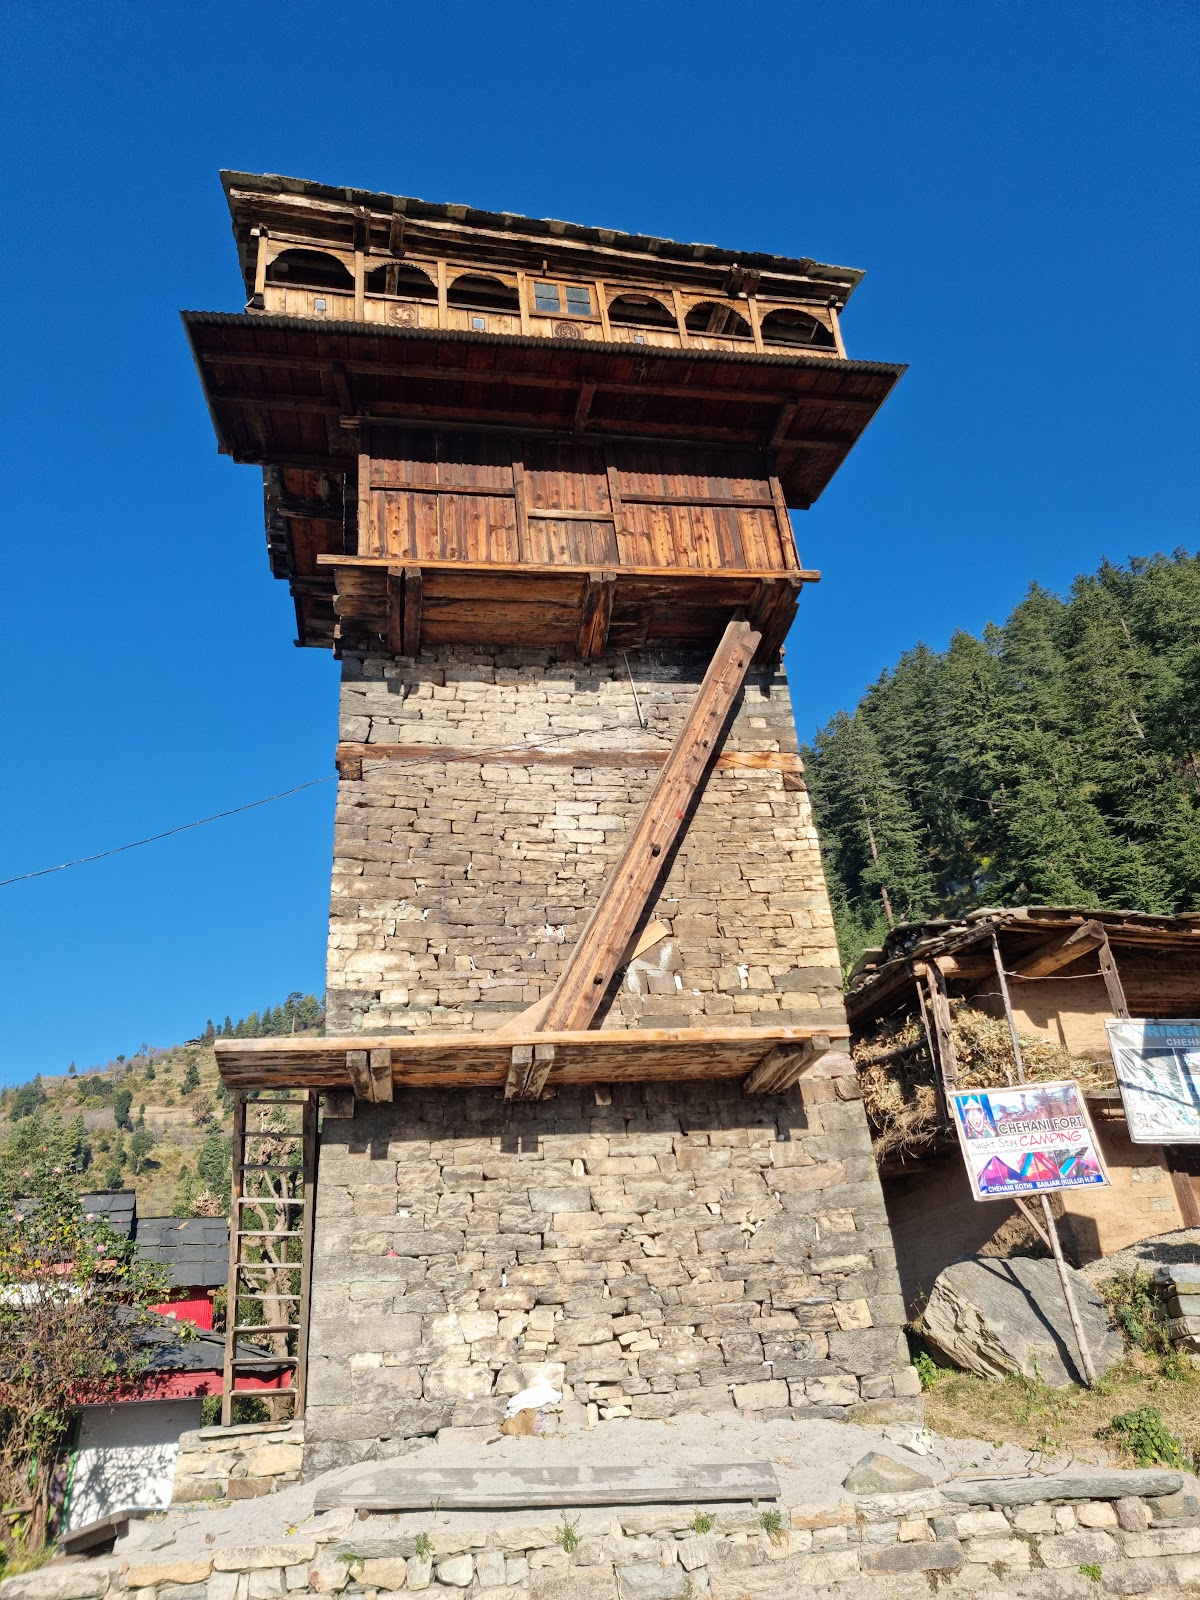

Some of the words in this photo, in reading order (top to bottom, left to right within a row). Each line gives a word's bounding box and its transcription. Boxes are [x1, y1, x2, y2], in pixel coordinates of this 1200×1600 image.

[998, 1119, 1051, 1134] CHEHANI
[1053, 1116, 1082, 1129] FORT
[997, 1137, 1018, 1149] Stay
[1019, 1130, 1082, 1147] CAMPING
[987, 1184, 1014, 1193] CHEHANI
[1014, 1182, 1033, 1191] KOTHI
[1035, 1179, 1061, 1188] BANJAR
[1060, 1176, 1085, 1187] (KULLU)
